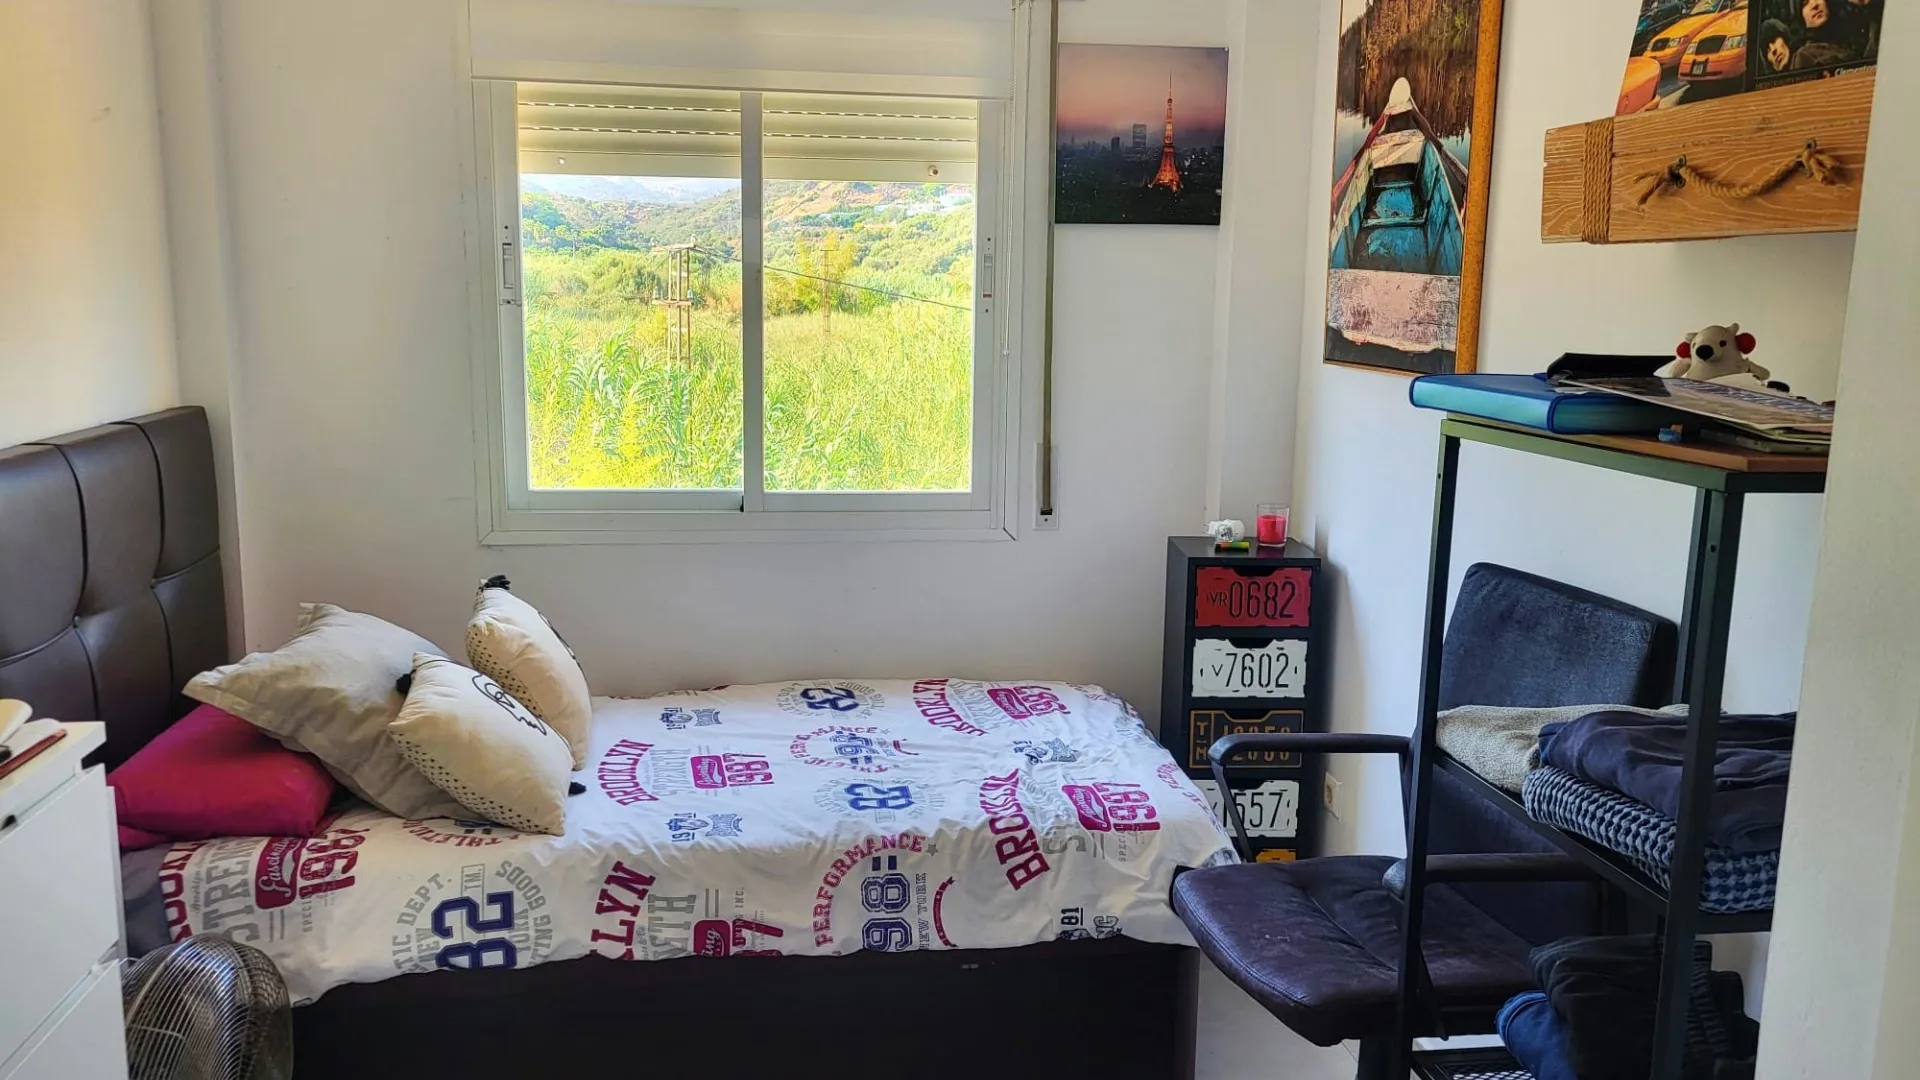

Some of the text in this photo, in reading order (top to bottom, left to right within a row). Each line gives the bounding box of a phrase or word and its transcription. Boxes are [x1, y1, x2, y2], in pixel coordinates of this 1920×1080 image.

[598, 739, 660, 806] BROOKLYN
[397, 872, 453, 927] DEPT.
[495, 860, 547, 911] GOODS
[431, 890, 518, 971] 82
